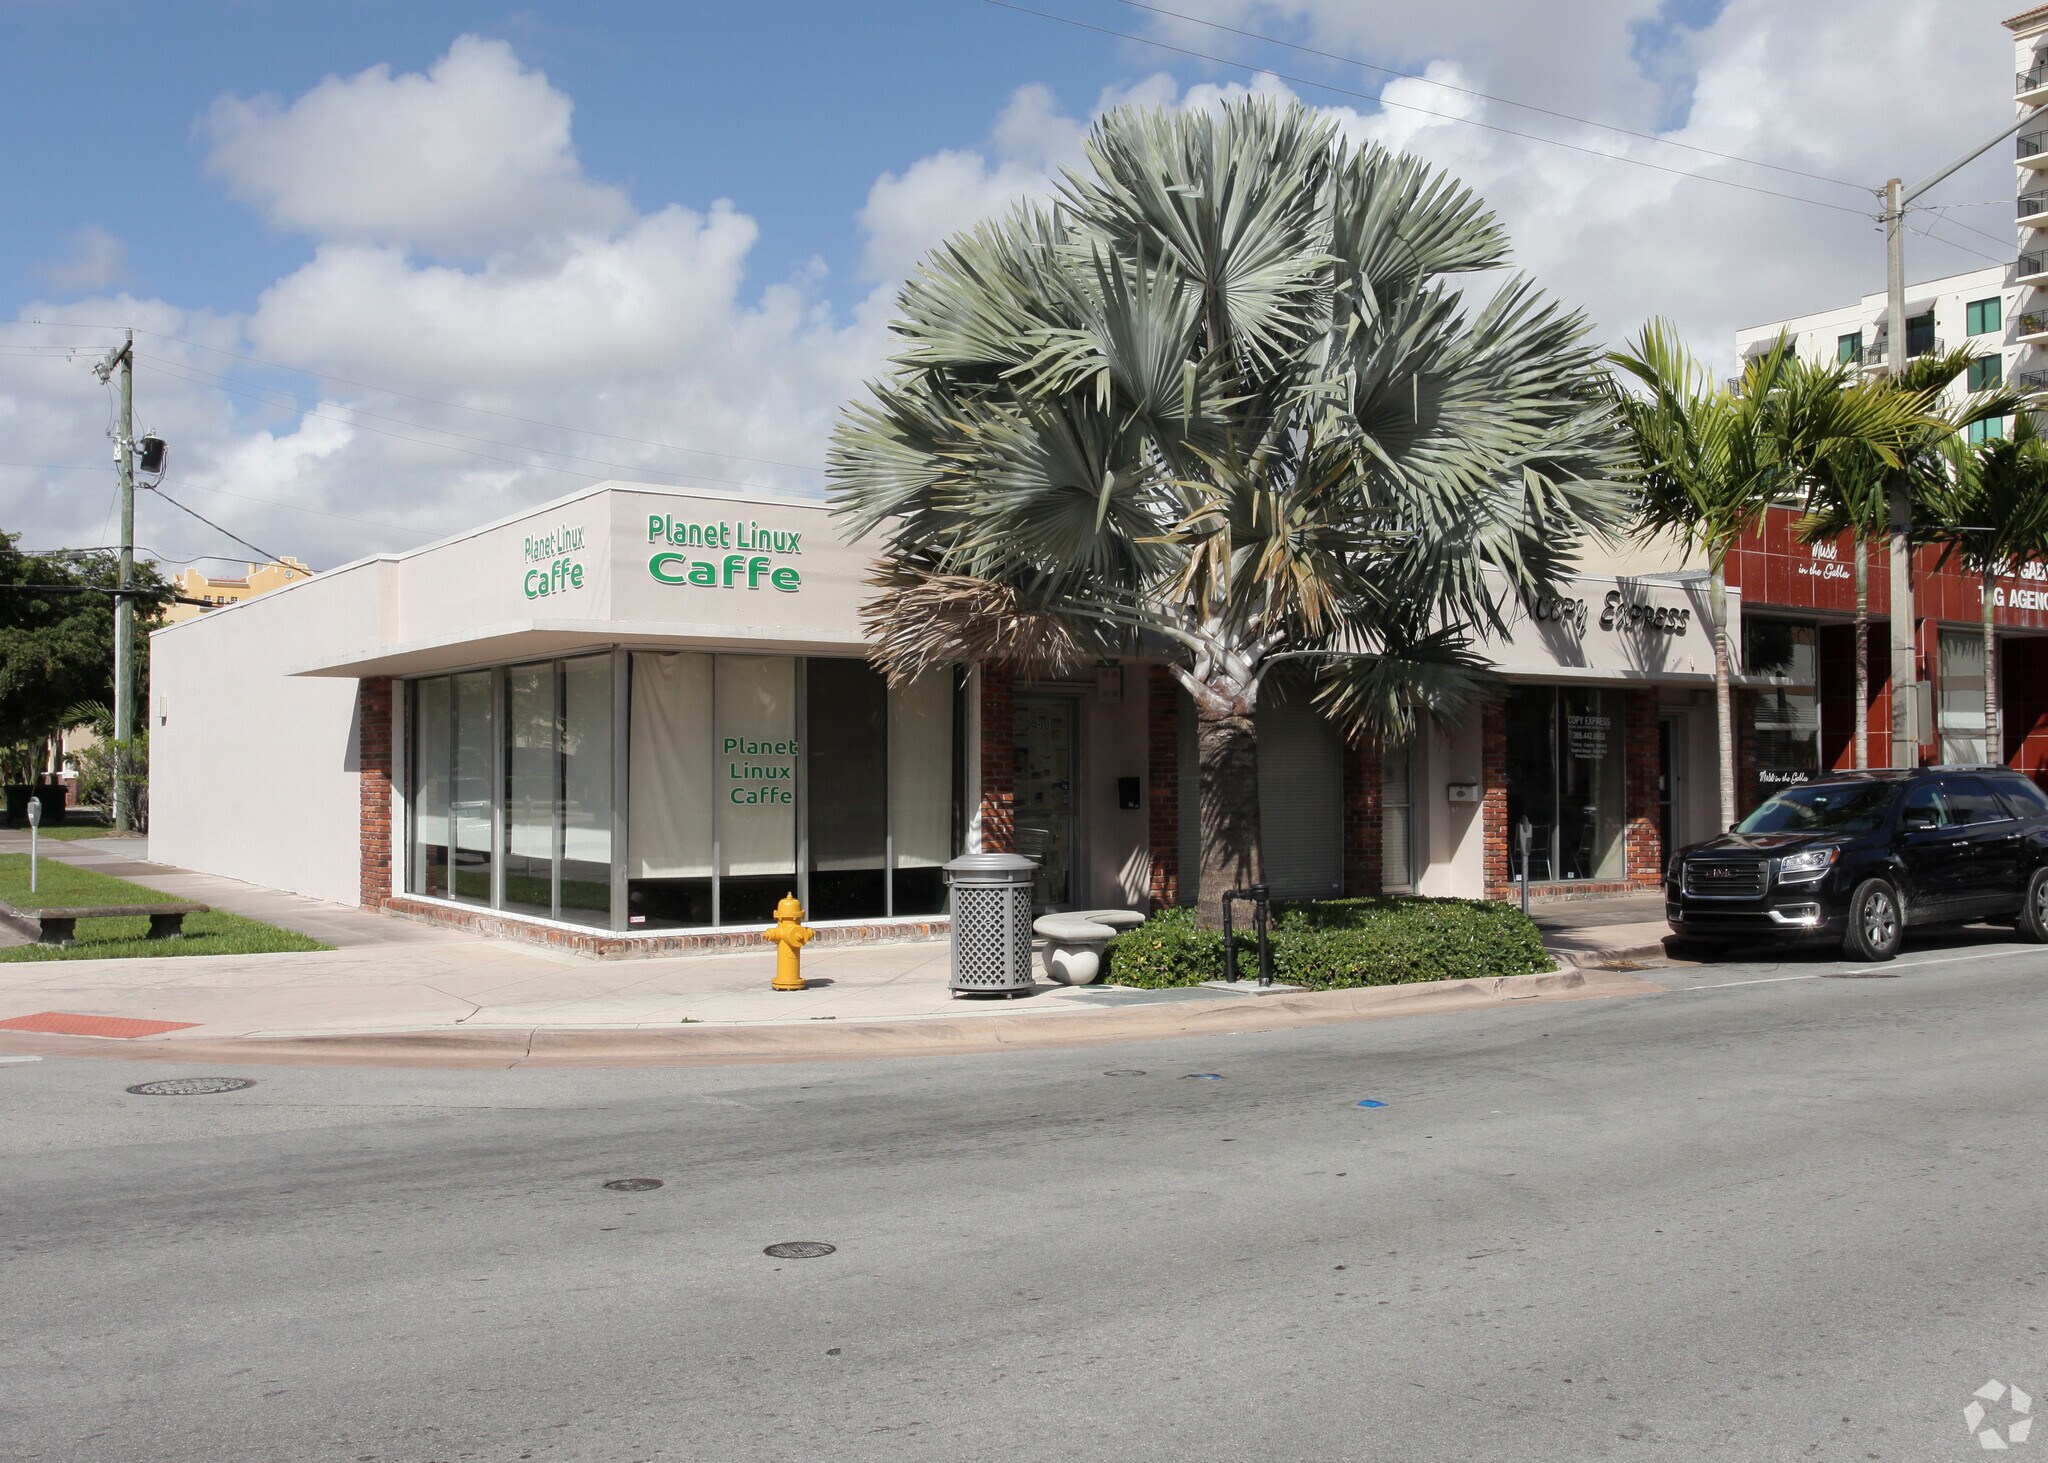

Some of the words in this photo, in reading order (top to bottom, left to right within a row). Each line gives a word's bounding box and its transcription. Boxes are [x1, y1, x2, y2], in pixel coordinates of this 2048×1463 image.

[524, 531, 555, 562] Planet
[557, 523, 585, 555] Linux
[647, 513, 730, 548] Planet
[736, 520, 801, 553] Linux
[1811, 539, 1838, 560] Muse
[524, 556, 584, 598] Caffe
[647, 551, 801, 592] Caffe
[1798, 563, 1808, 574] in
[1809, 562, 1822, 576] the
[1978, 585, 2004, 606] TG
[1568, 715, 1584, 725] COPY
[1584, 716, 1611, 727] EXPRESS
[723, 736, 798, 755] Planet
[730, 761, 791, 779] Linux
[730, 786, 792, 804] Caffe
